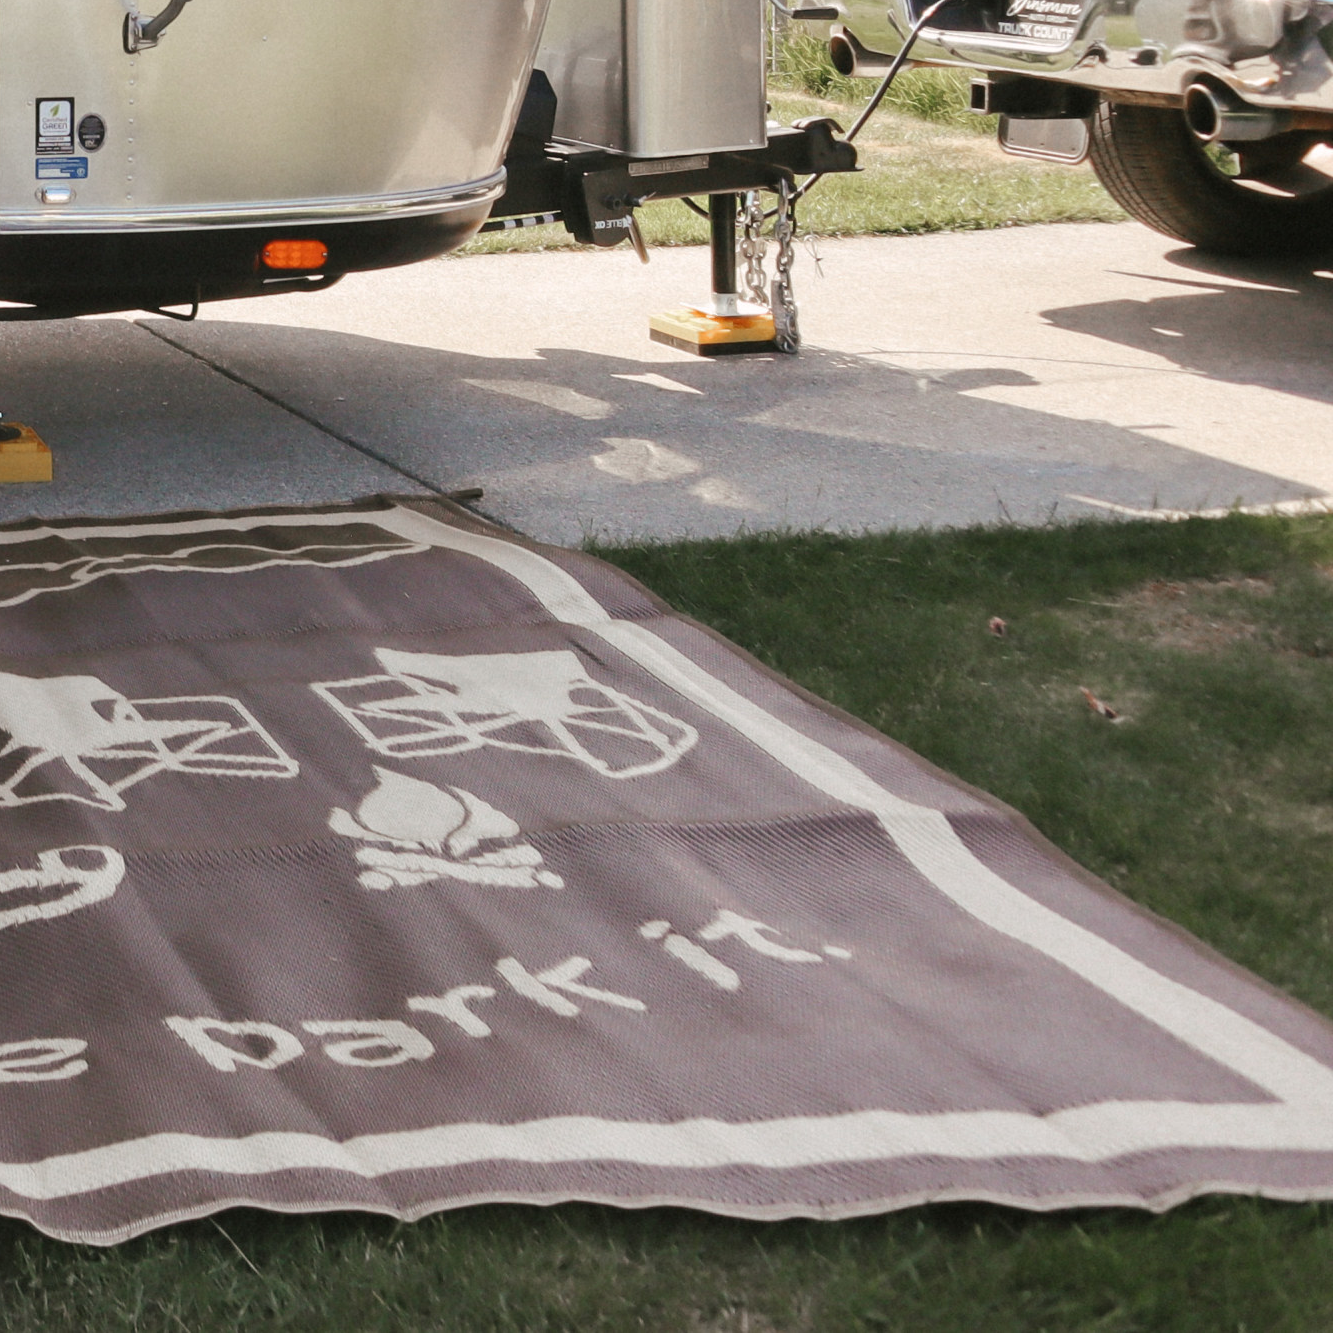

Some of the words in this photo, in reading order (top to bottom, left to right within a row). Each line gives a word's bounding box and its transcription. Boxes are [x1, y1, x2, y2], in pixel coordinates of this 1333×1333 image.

[998, 21, 1032, 37] TRUCK
[594, 220, 606, 230] OX
[165, 954, 648, 1073] park
